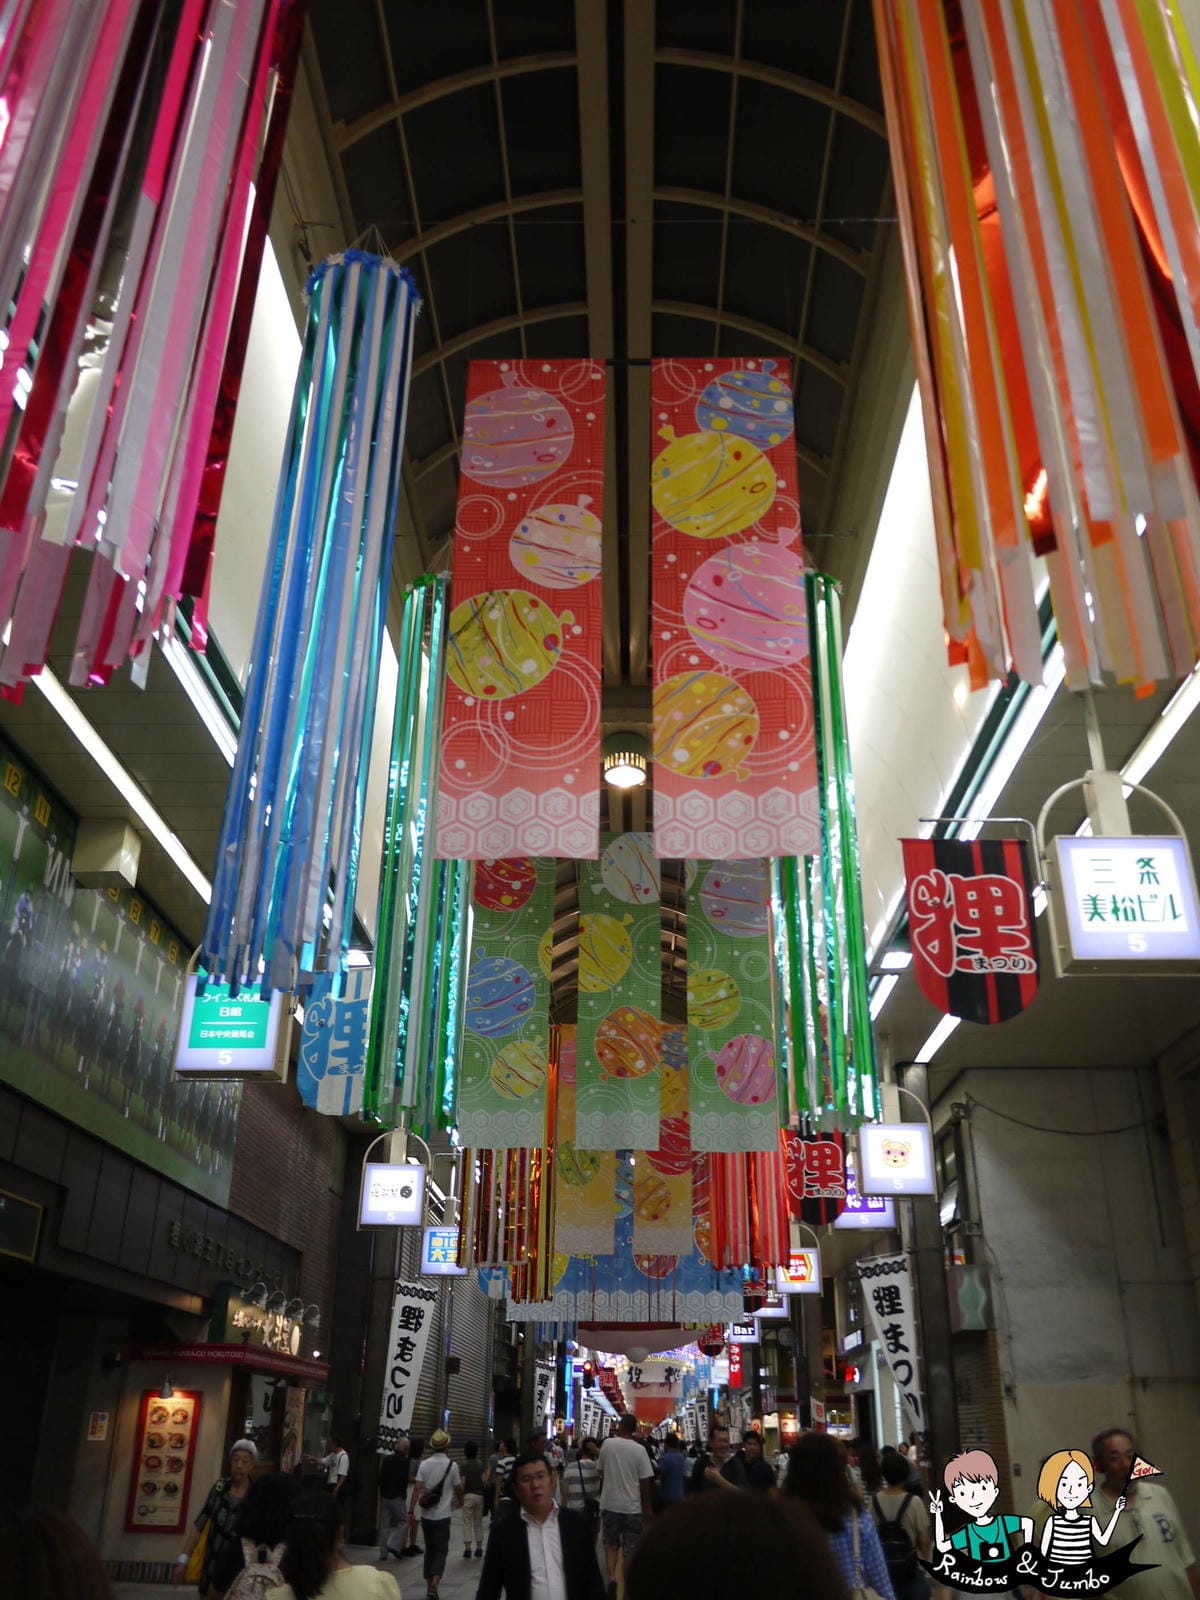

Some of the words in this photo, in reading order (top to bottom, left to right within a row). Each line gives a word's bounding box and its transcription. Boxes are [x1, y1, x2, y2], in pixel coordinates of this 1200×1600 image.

[1082, 895, 1183, 923] 美松ビル
[910, 868, 1037, 978] 狸
[1128, 933, 1148, 952] 5
[973, 957, 1027, 971] まつり
[217, 1050, 232, 1065] 5
[337, 1063, 364, 1075] まつ
[894, 1178, 904, 1190] 5
[734, 1326, 754, 1335] Bar
[729, 1343, 741, 1373] みやげ
[873, 1284, 920, 1418] 狸まつり
